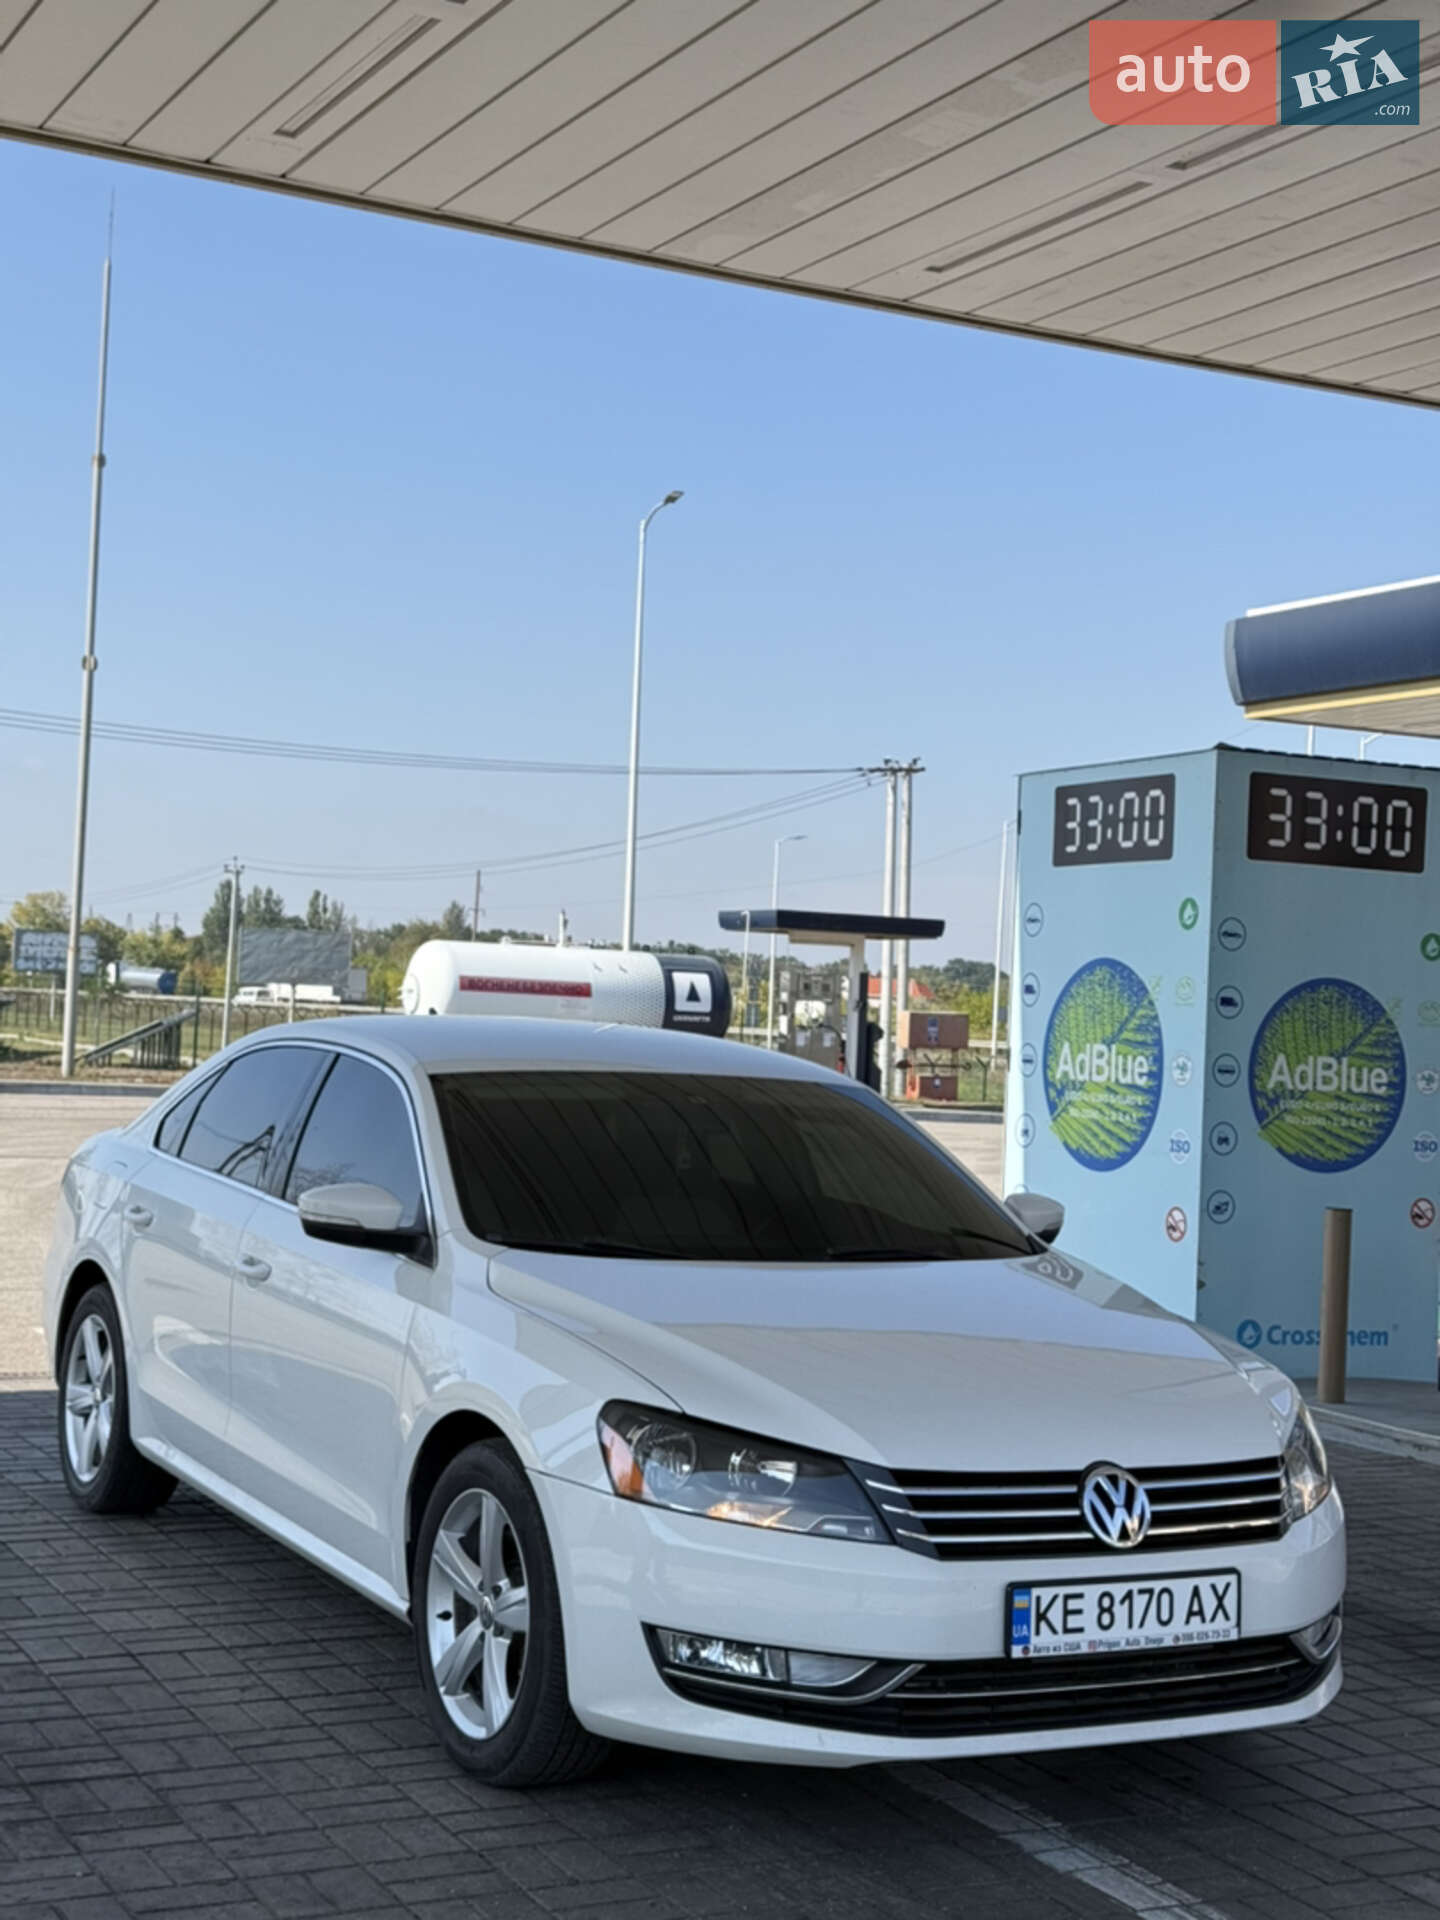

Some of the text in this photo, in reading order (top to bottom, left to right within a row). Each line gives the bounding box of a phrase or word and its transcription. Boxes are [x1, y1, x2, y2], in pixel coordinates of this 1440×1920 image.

[1065, 789, 1165, 852] 33:00
[1267, 788, 1412, 857] 33:00
[1056, 1042, 1149, 1085] AdBlue
[1267, 1053, 1388, 1094] AdBlue
[1169, 1138, 1191, 1154] ISO
[1413, 1140, 1438, 1153] ISO
[1034, 1581, 1232, 1636] KE 8170 AX
[1013, 1625, 1029, 1638] UA
